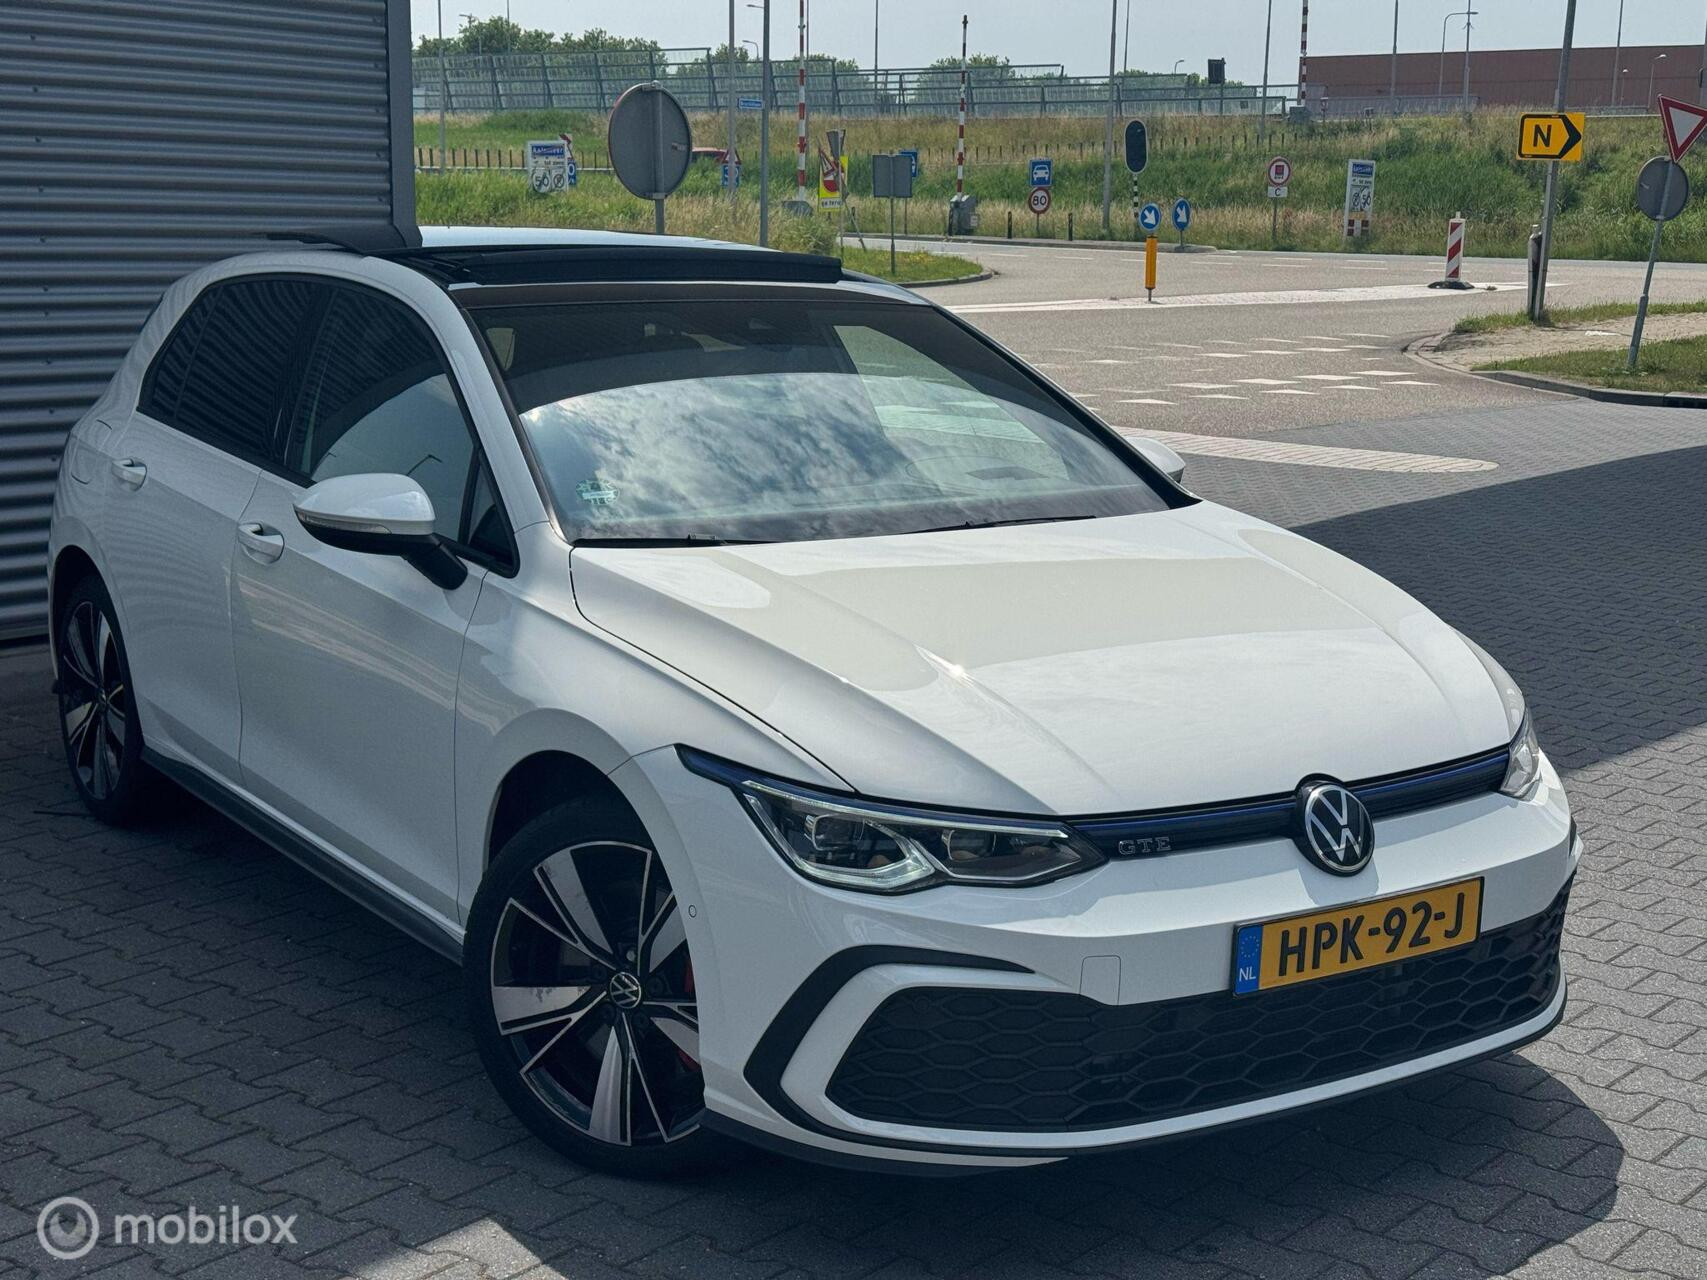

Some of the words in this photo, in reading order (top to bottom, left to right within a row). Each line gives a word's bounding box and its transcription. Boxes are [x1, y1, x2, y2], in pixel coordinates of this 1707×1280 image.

[1533, 124, 1552, 148] N
[1032, 195, 1047, 206] 80
[1274, 187, 1281, 197] C
[1117, 836, 1172, 856] GTE
[1278, 892, 1465, 977] HPK-92-J
[1238, 966, 1257, 982] NL
